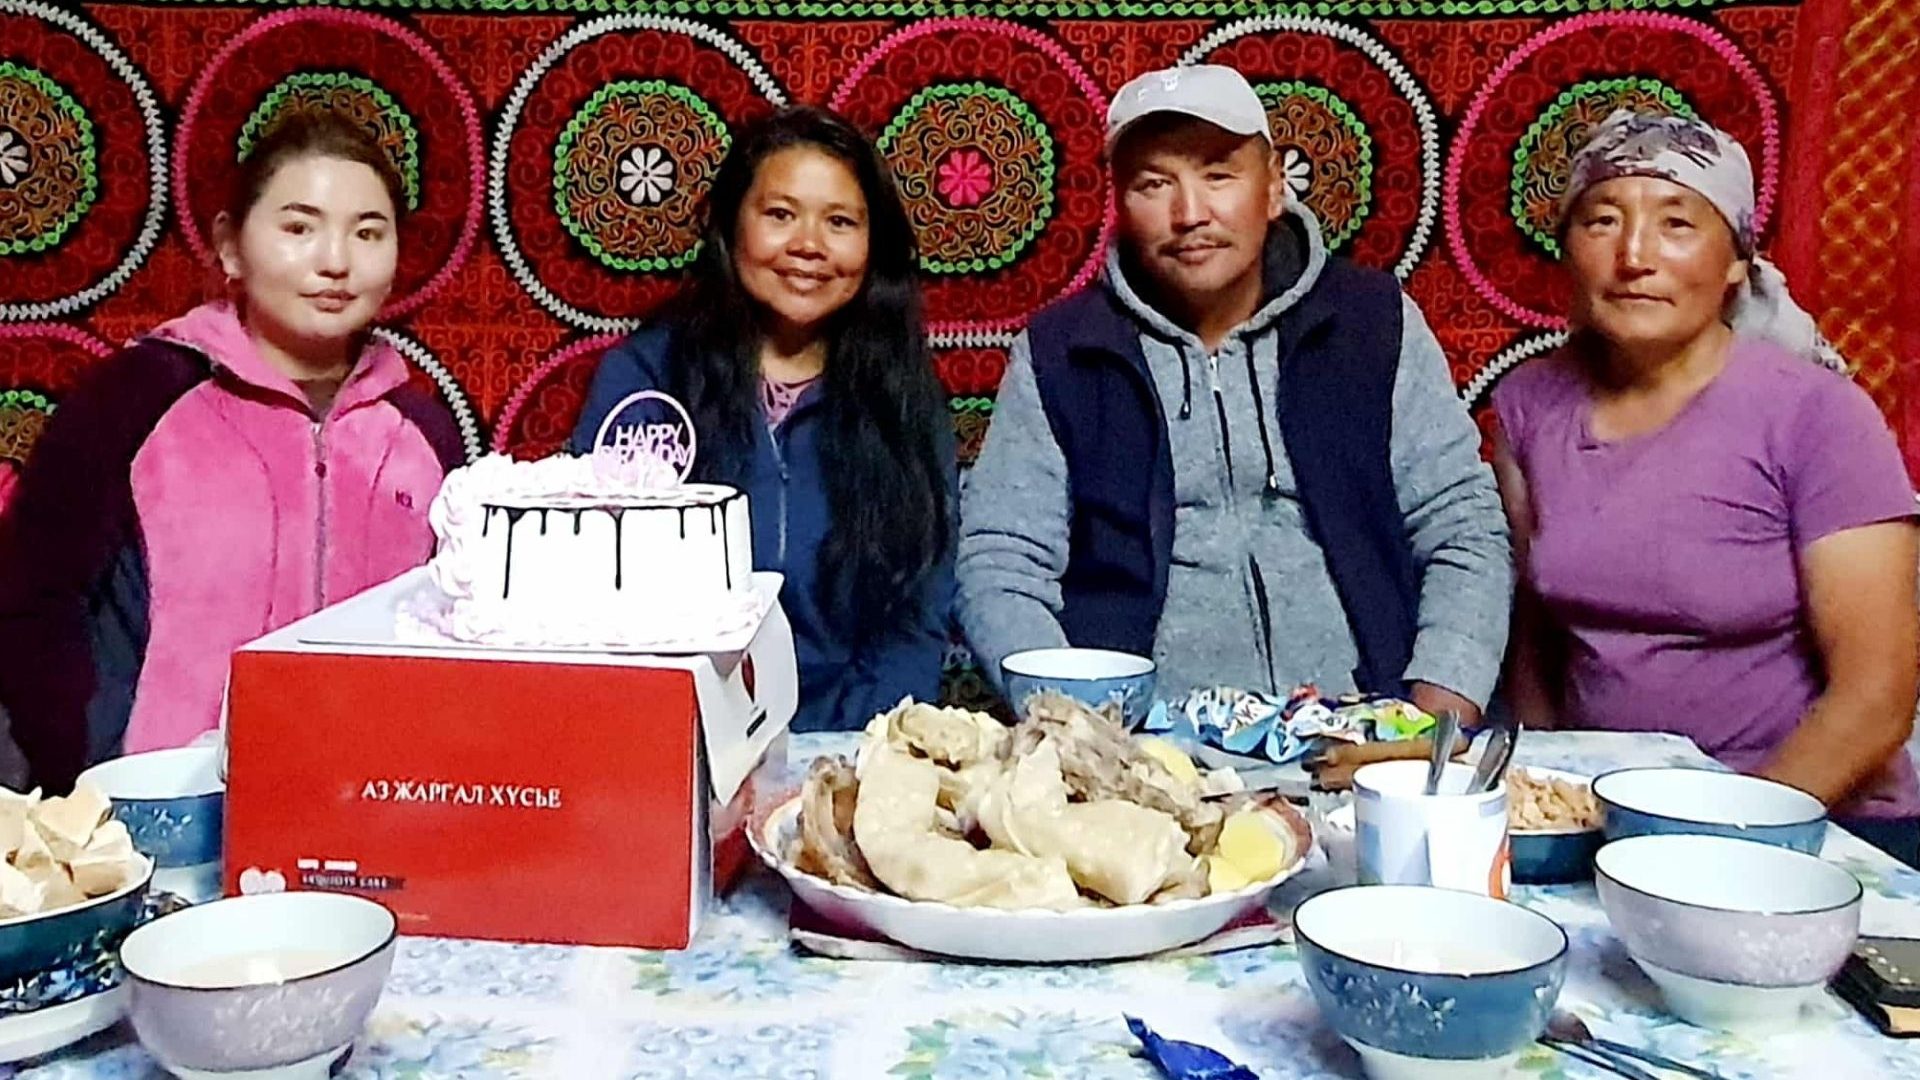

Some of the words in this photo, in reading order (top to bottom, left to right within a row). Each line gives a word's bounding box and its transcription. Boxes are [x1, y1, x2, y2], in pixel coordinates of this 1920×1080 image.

[616, 423, 682, 446] HAPPY
[600, 443, 691, 467] BRDAY
[361, 780, 389, 800] АЗ
[393, 780, 484, 805] ЖАРГАЛ
